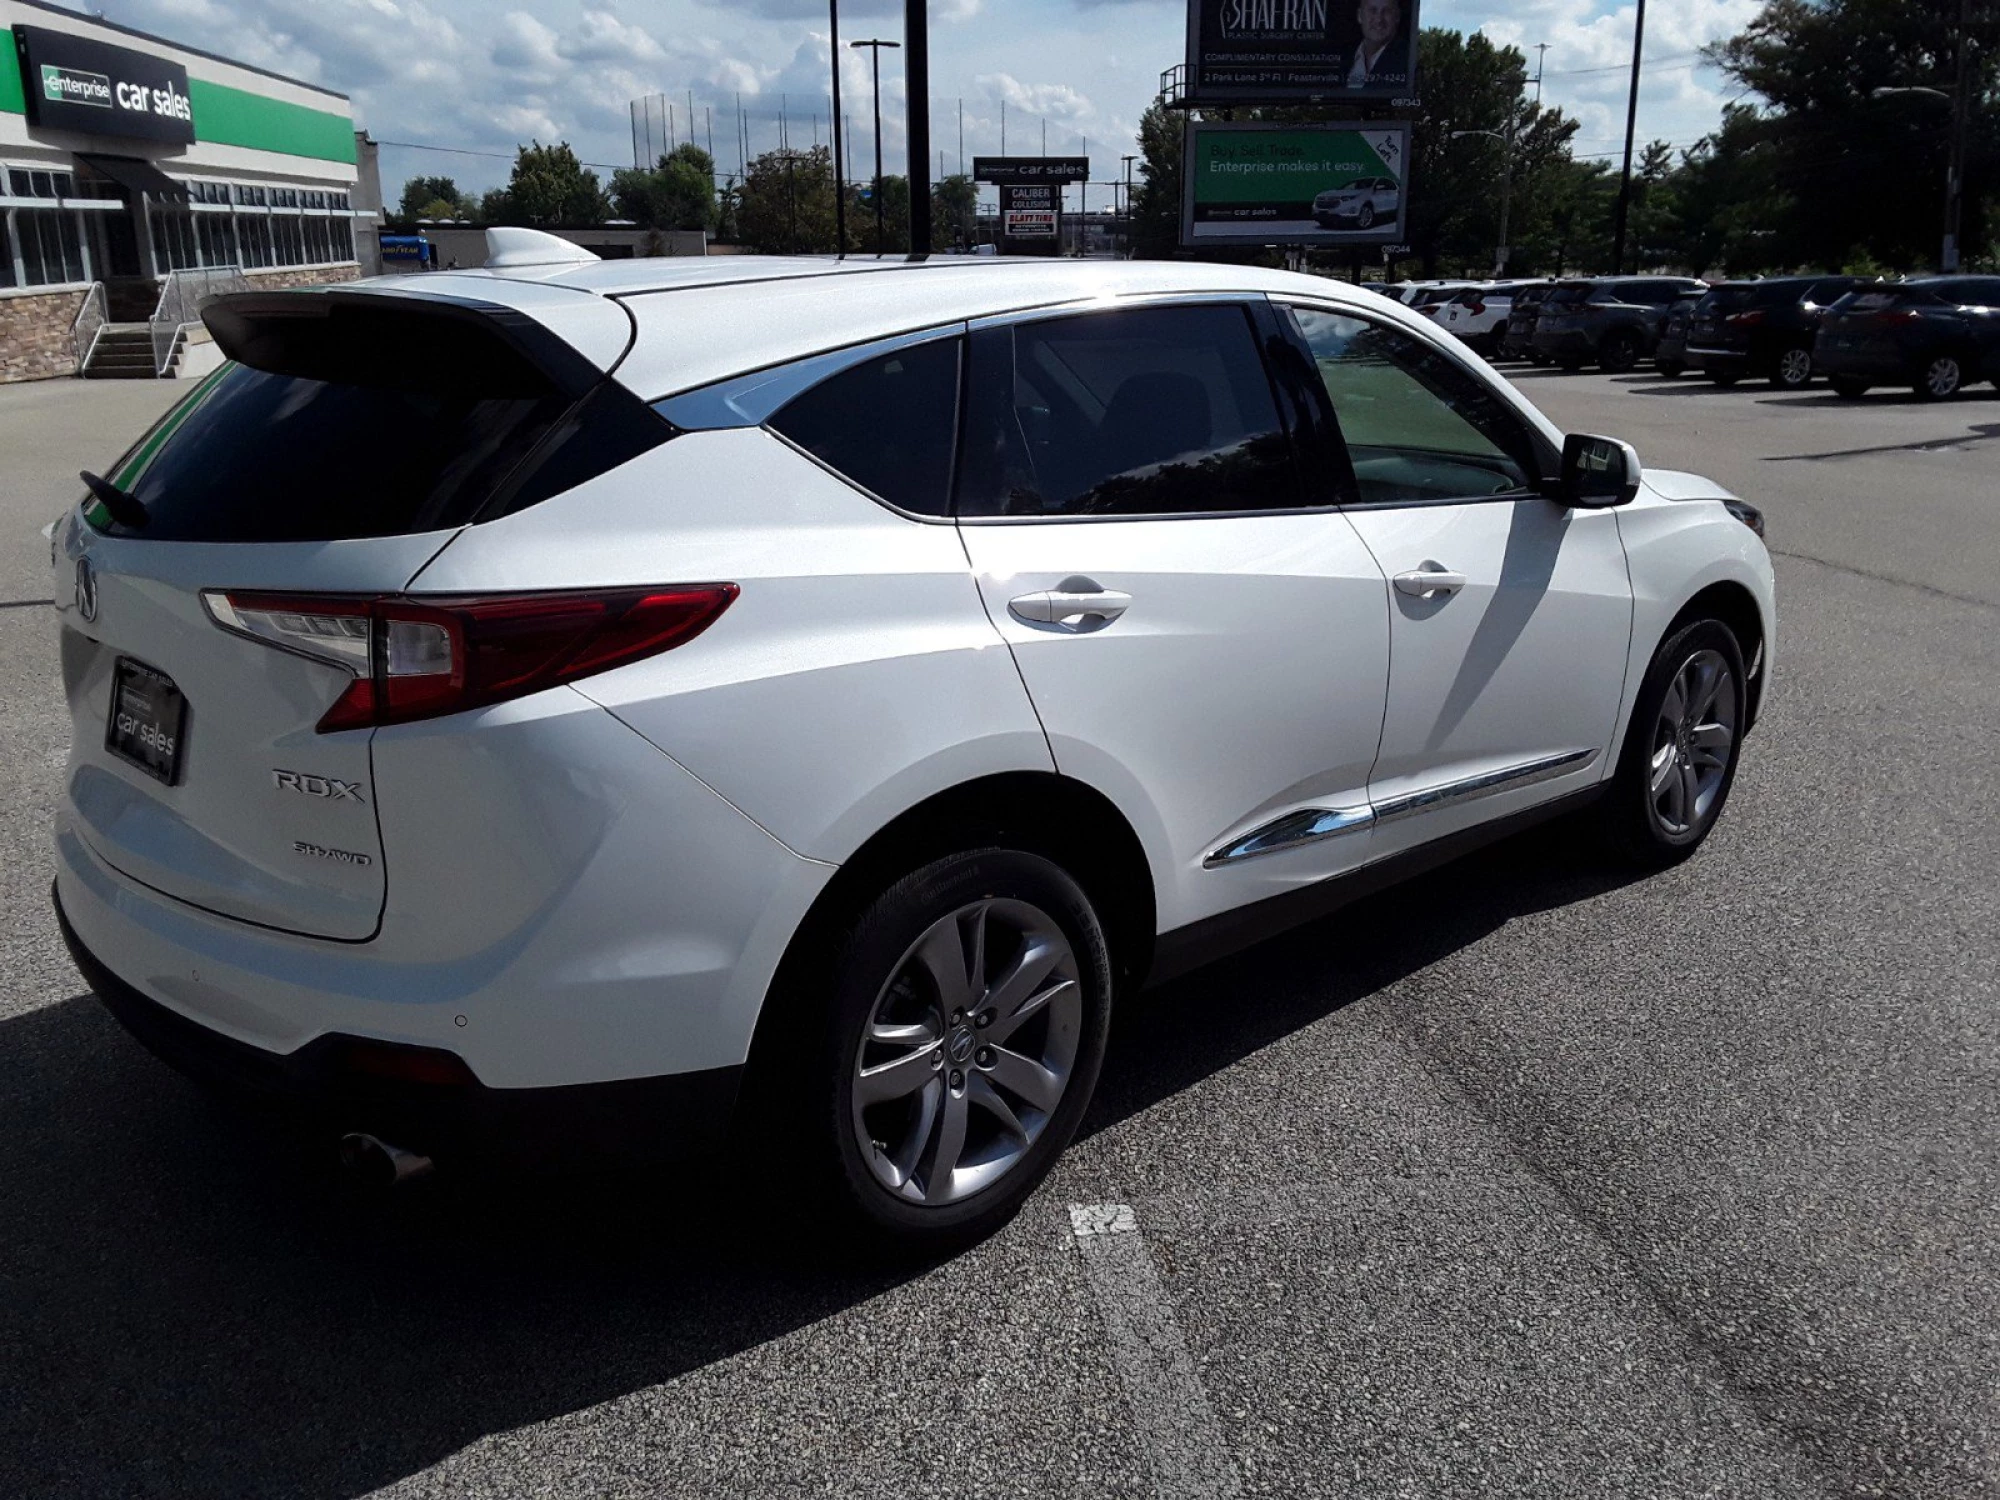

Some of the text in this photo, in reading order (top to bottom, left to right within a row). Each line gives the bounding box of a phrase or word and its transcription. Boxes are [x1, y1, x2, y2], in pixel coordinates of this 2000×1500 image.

[1229, 0, 1328, 30] SHAFRAN
[1204, 53, 1341, 62] COMPLIMENTARY CONSULTATION
[1204, 73, 1210, 82] 2
[1212, 73, 1232, 82] Park
[1234, 73, 1257, 82] Lane
[1288, 73, 1340, 82] Feasterville
[46, 75, 191, 121] enterprise car sales
[1376, 143, 1392, 162] Left
[1385, 135, 1399, 155] Turn
[1019, 165, 1043, 174] car
[1045, 162, 1084, 175] sales
[1210, 160, 1274, 174] Enterprise
[1278, 160, 1318, 171] makes
[1322, 160, 1332, 171] it
[1012, 188, 1050, 198] CALIBER
[1012, 200, 1050, 209] COLLISION
[1035, 214, 1054, 222] TIRE
[117, 713, 175, 756] car sales
[271, 768, 366, 803] RDX
[293, 841, 371, 867] SH-AWD
